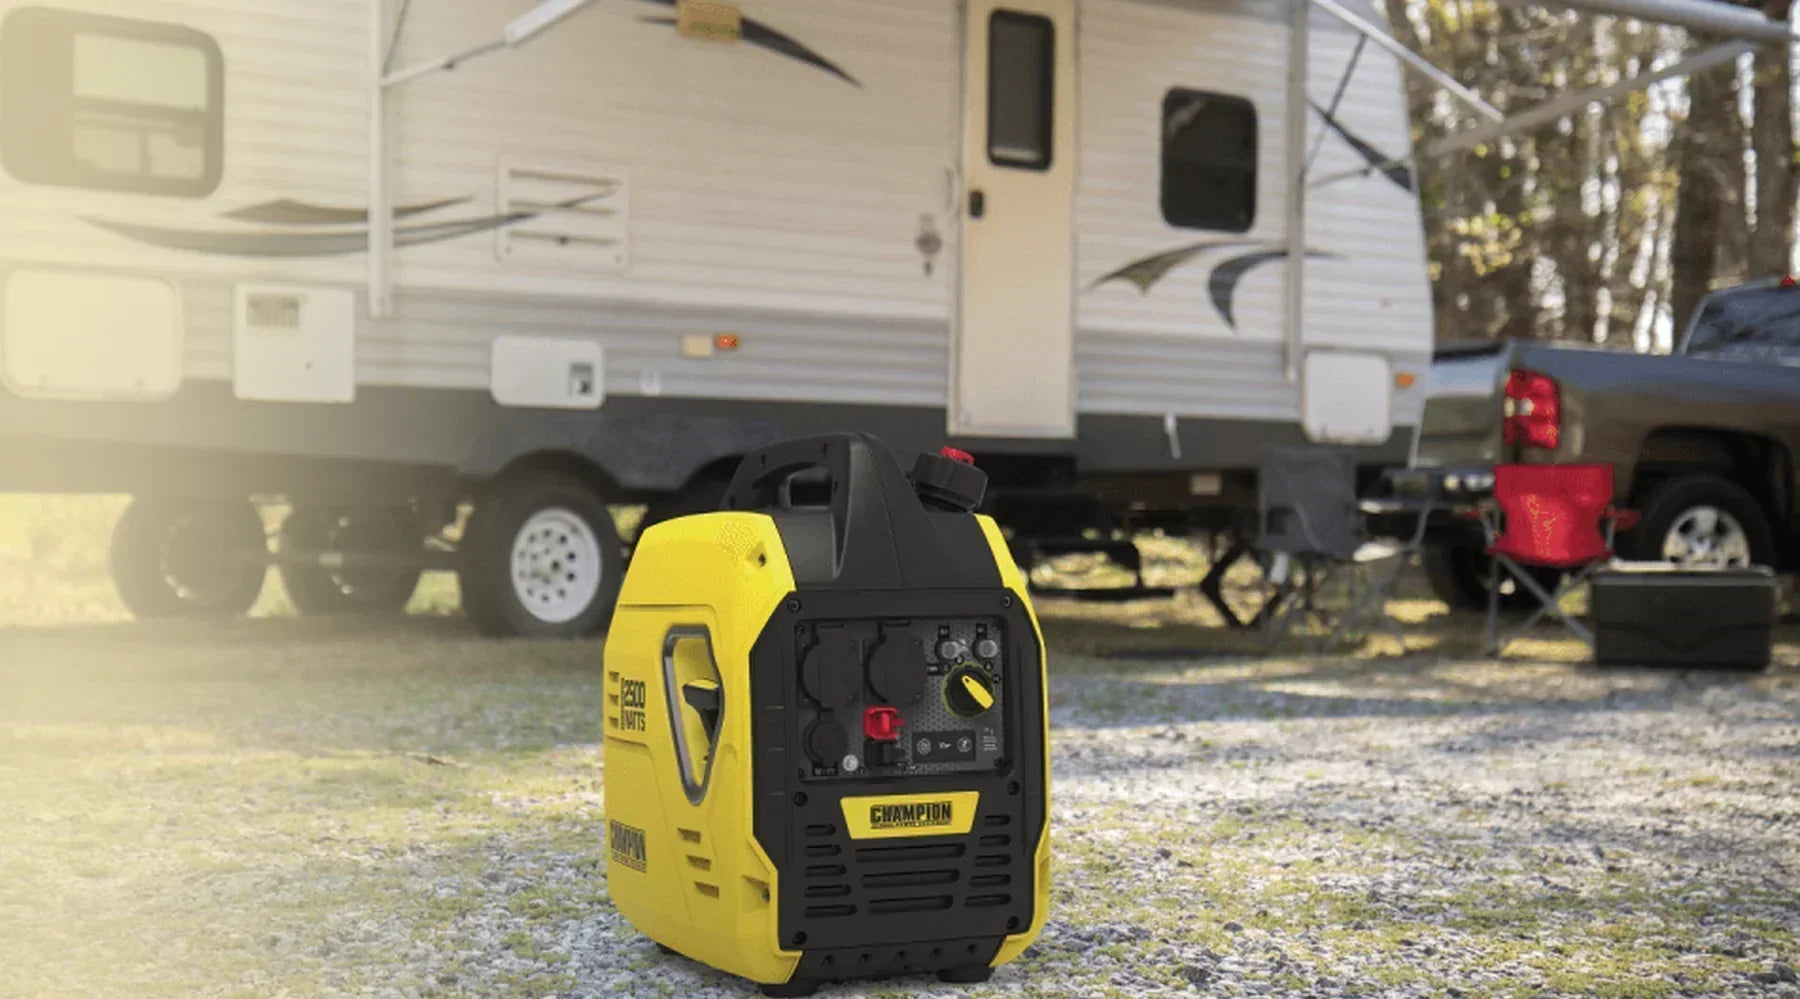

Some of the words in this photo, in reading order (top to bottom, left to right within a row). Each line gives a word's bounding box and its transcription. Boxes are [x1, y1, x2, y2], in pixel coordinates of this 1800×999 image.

[624, 680, 646, 708] 2500
[624, 710, 646, 731] WATTS
[870, 802, 952, 824] CHAMPION
